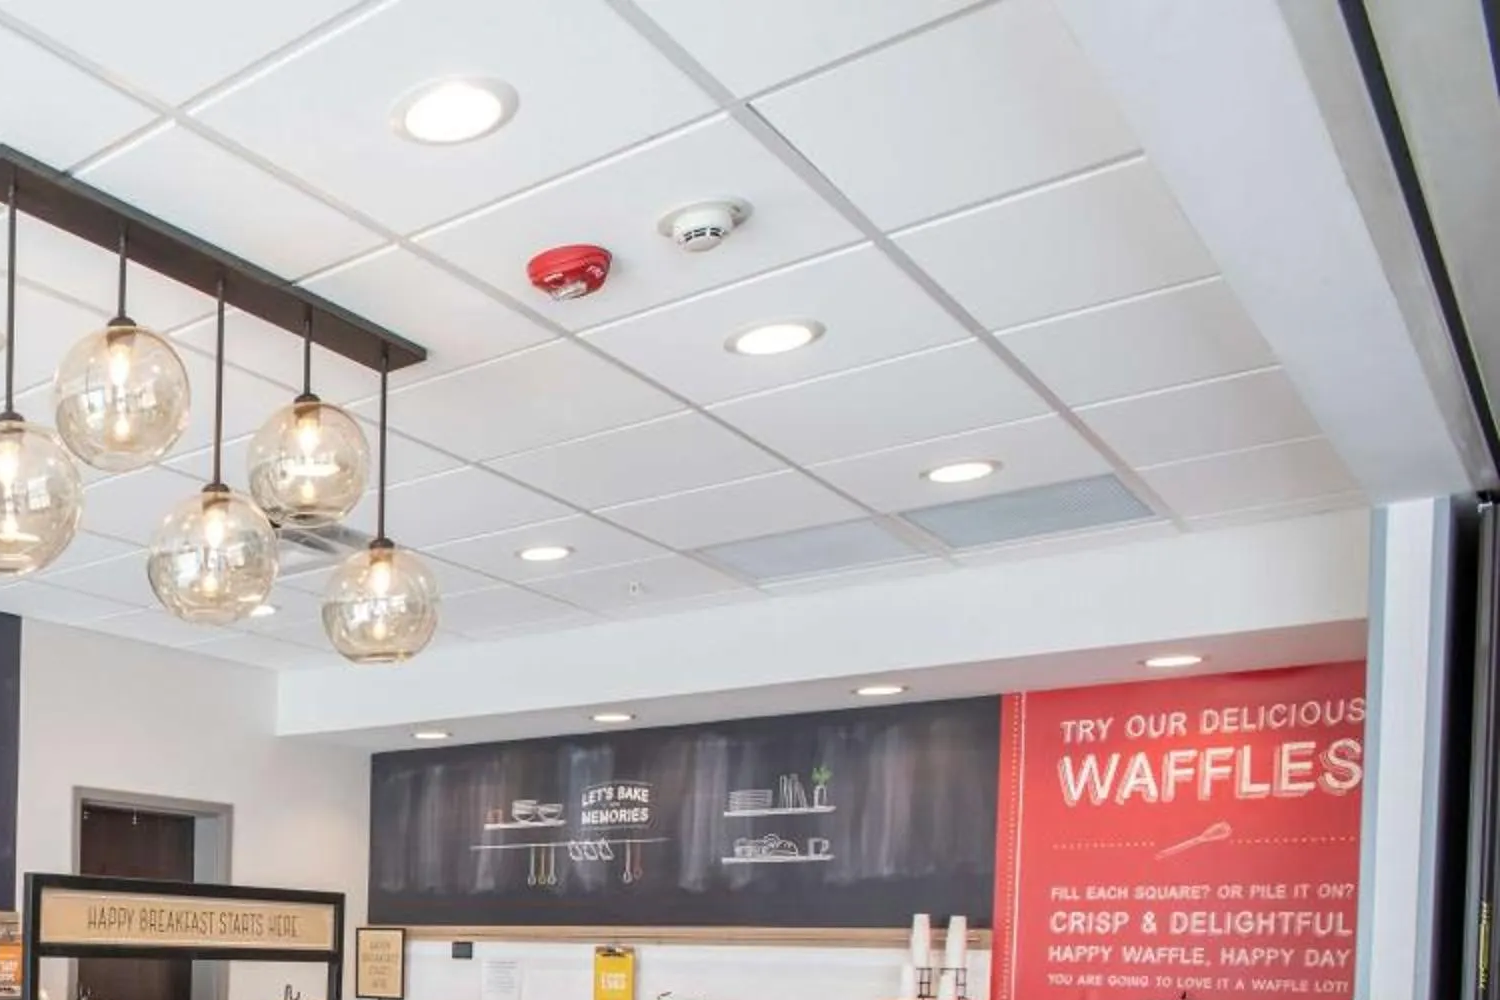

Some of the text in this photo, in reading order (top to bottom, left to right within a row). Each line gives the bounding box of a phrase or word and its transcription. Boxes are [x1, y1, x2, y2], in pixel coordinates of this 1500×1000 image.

[1060, 697, 1365, 744] TRY OUR DELICIOUS
[1057, 738, 1363, 807] WAFFLES
[581, 787, 614, 807] LET'S
[617, 785, 649, 803] BAKE
[581, 807, 649, 826] MEMORIES
[1051, 883, 1354, 900] FILL EACH SQUARE? OR PILE IT ON?
[87, 906, 299, 938] HAPPY BREAKFAST STARTS HERE
[1050, 911, 1353, 936] CRISP & DELIGHTFUL
[1047, 945, 1113, 963] HAPPY
[1220, 947, 1296, 967] HAPPY
[1304, 949, 1351, 968] DAY
[1047, 973, 1073, 986] YOU
[1077, 974, 1102, 987] ARE
[1107, 975, 1150, 988] GOING
[1155, 976, 1172, 988] TO
[1177, 976, 1212, 989] LOVE
[1217, 978, 1230, 990] IT
[1234, 979, 1245, 990] A
[1251, 978, 1309, 992] WAFFLE
